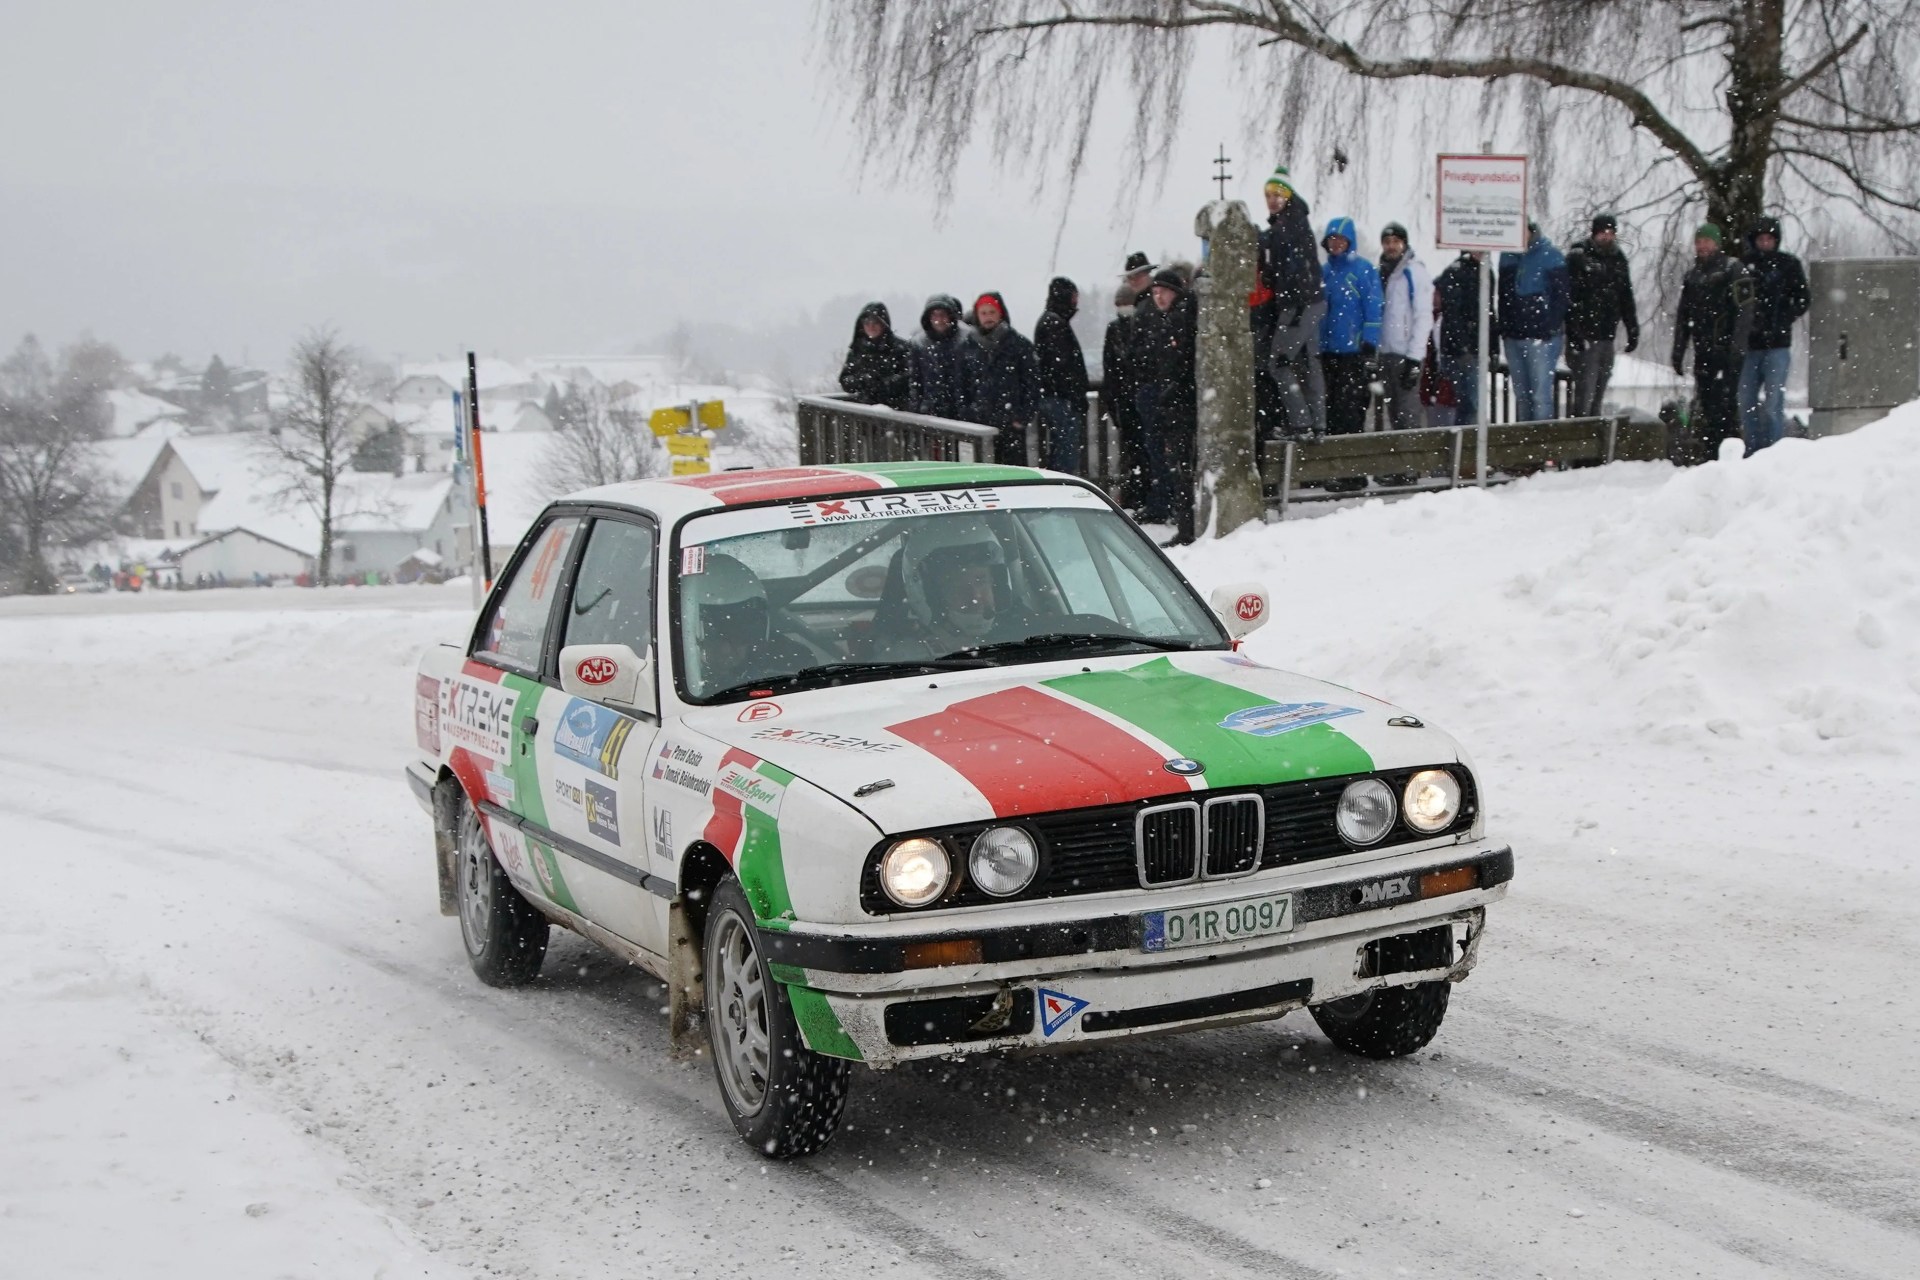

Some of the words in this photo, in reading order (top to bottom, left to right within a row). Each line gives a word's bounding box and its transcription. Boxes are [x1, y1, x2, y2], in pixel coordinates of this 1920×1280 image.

[1444, 169, 1521, 184] Privatgrundstück
[788, 488, 1000, 520] EXTREME
[821, 503, 980, 522] WWW.EXTREME-TYRES.CZ
[441, 677, 514, 739] EXTREME
[750, 727, 903, 752] EXTREME
[671, 745, 690, 761] Pavel
